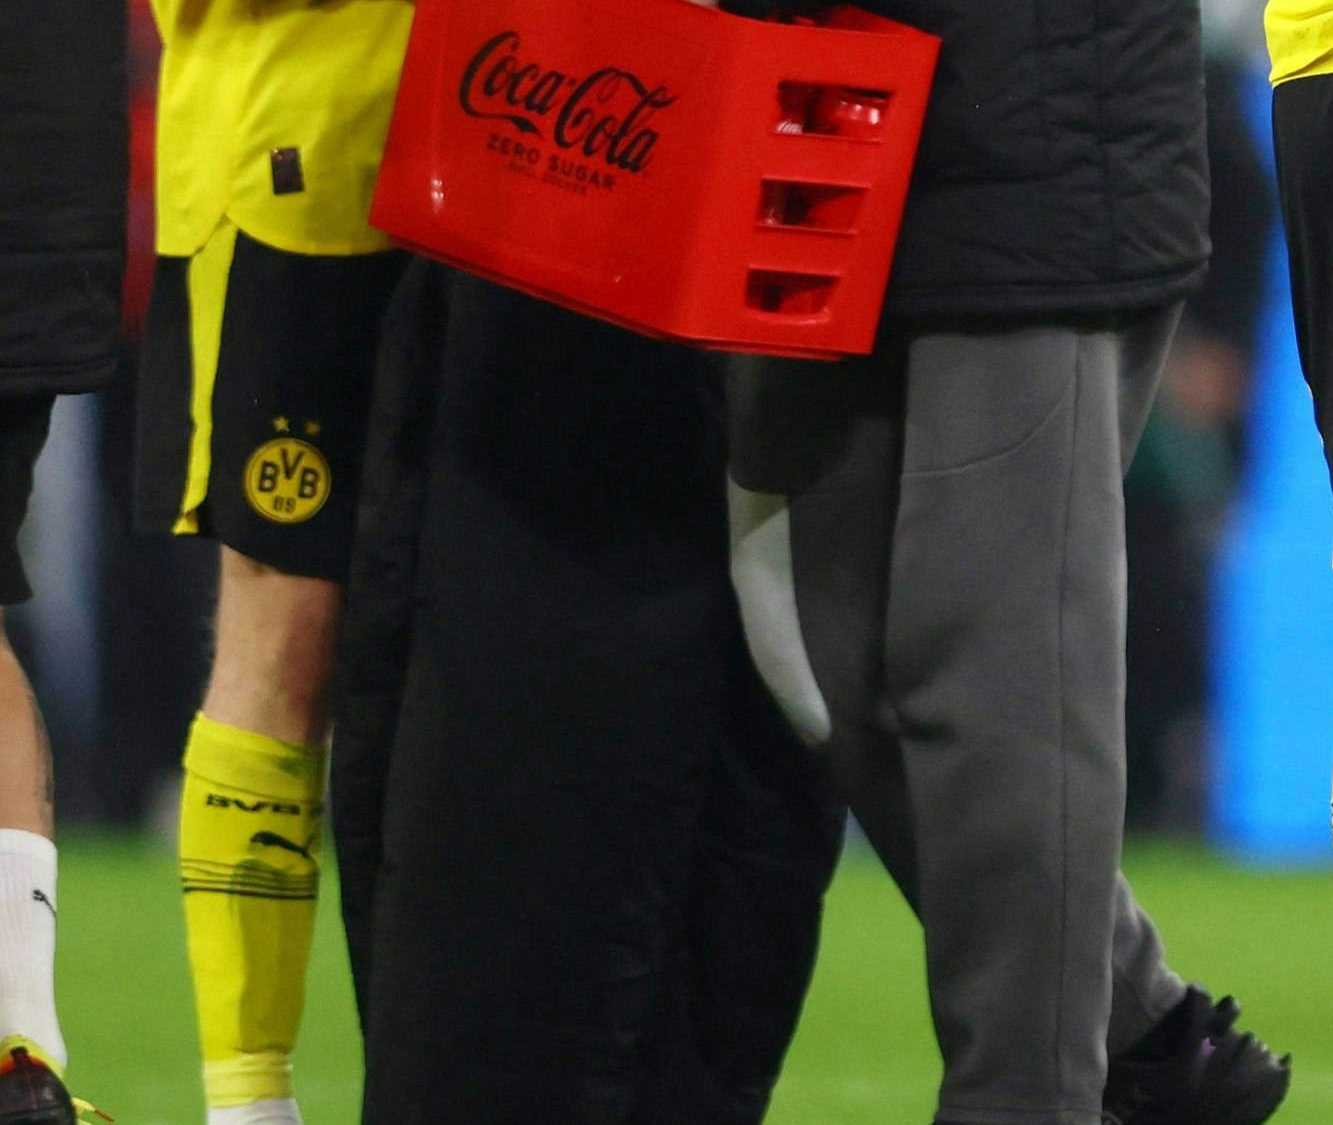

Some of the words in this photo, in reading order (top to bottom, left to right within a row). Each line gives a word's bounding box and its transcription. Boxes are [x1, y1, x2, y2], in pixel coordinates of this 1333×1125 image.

[459, 30, 679, 173] Coca-Cola
[487, 132, 541, 165] ZERO
[548, 154, 616, 191] SUGAR
[258, 446, 321, 499] BVB
